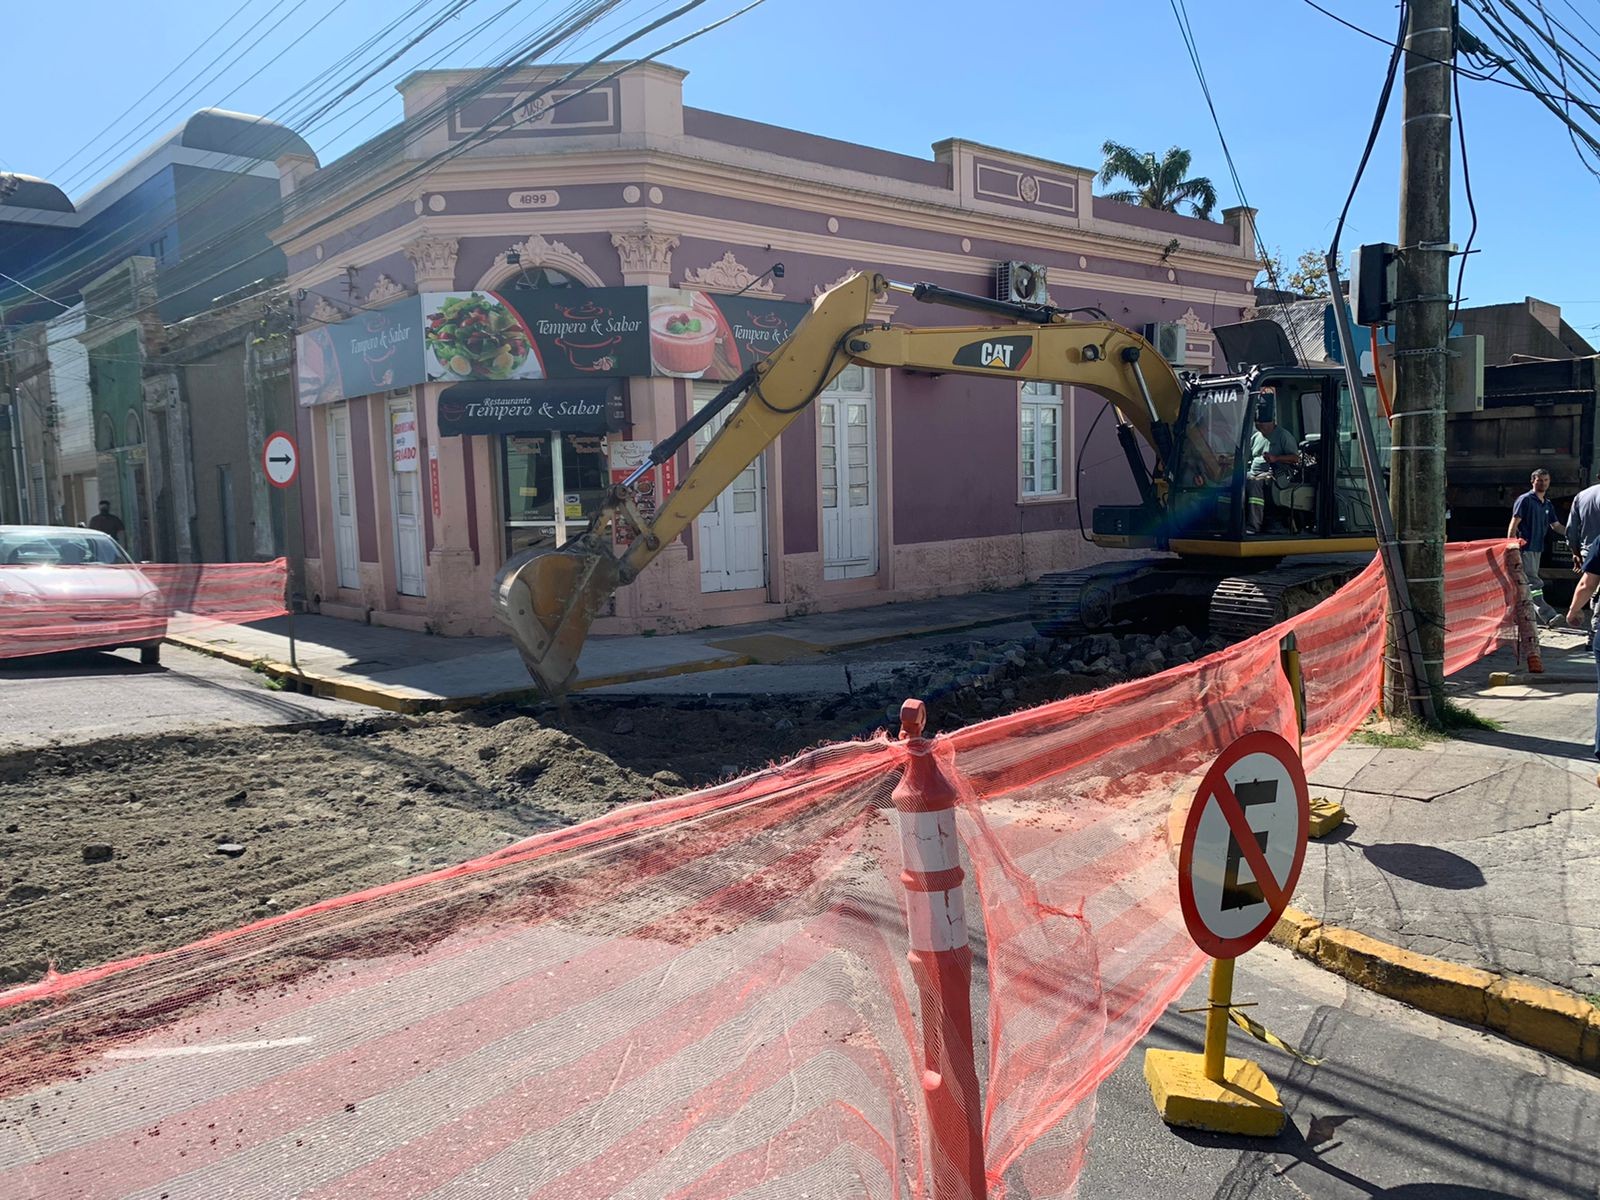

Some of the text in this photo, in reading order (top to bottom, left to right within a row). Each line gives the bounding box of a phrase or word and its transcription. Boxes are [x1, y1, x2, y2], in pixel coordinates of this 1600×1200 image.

[536, 315, 643, 339] Tempero & Sabor
[732, 324, 770, 345] Tempero
[772, 328, 781, 345] &
[980, 342, 1014, 368] CAT
[465, 402, 532, 420] Tempero
[538, 401, 555, 419] &
[557, 399, 605, 416] Sabor
[484, 397, 531, 406] Restaurante
[1221, 779, 1279, 912] E
